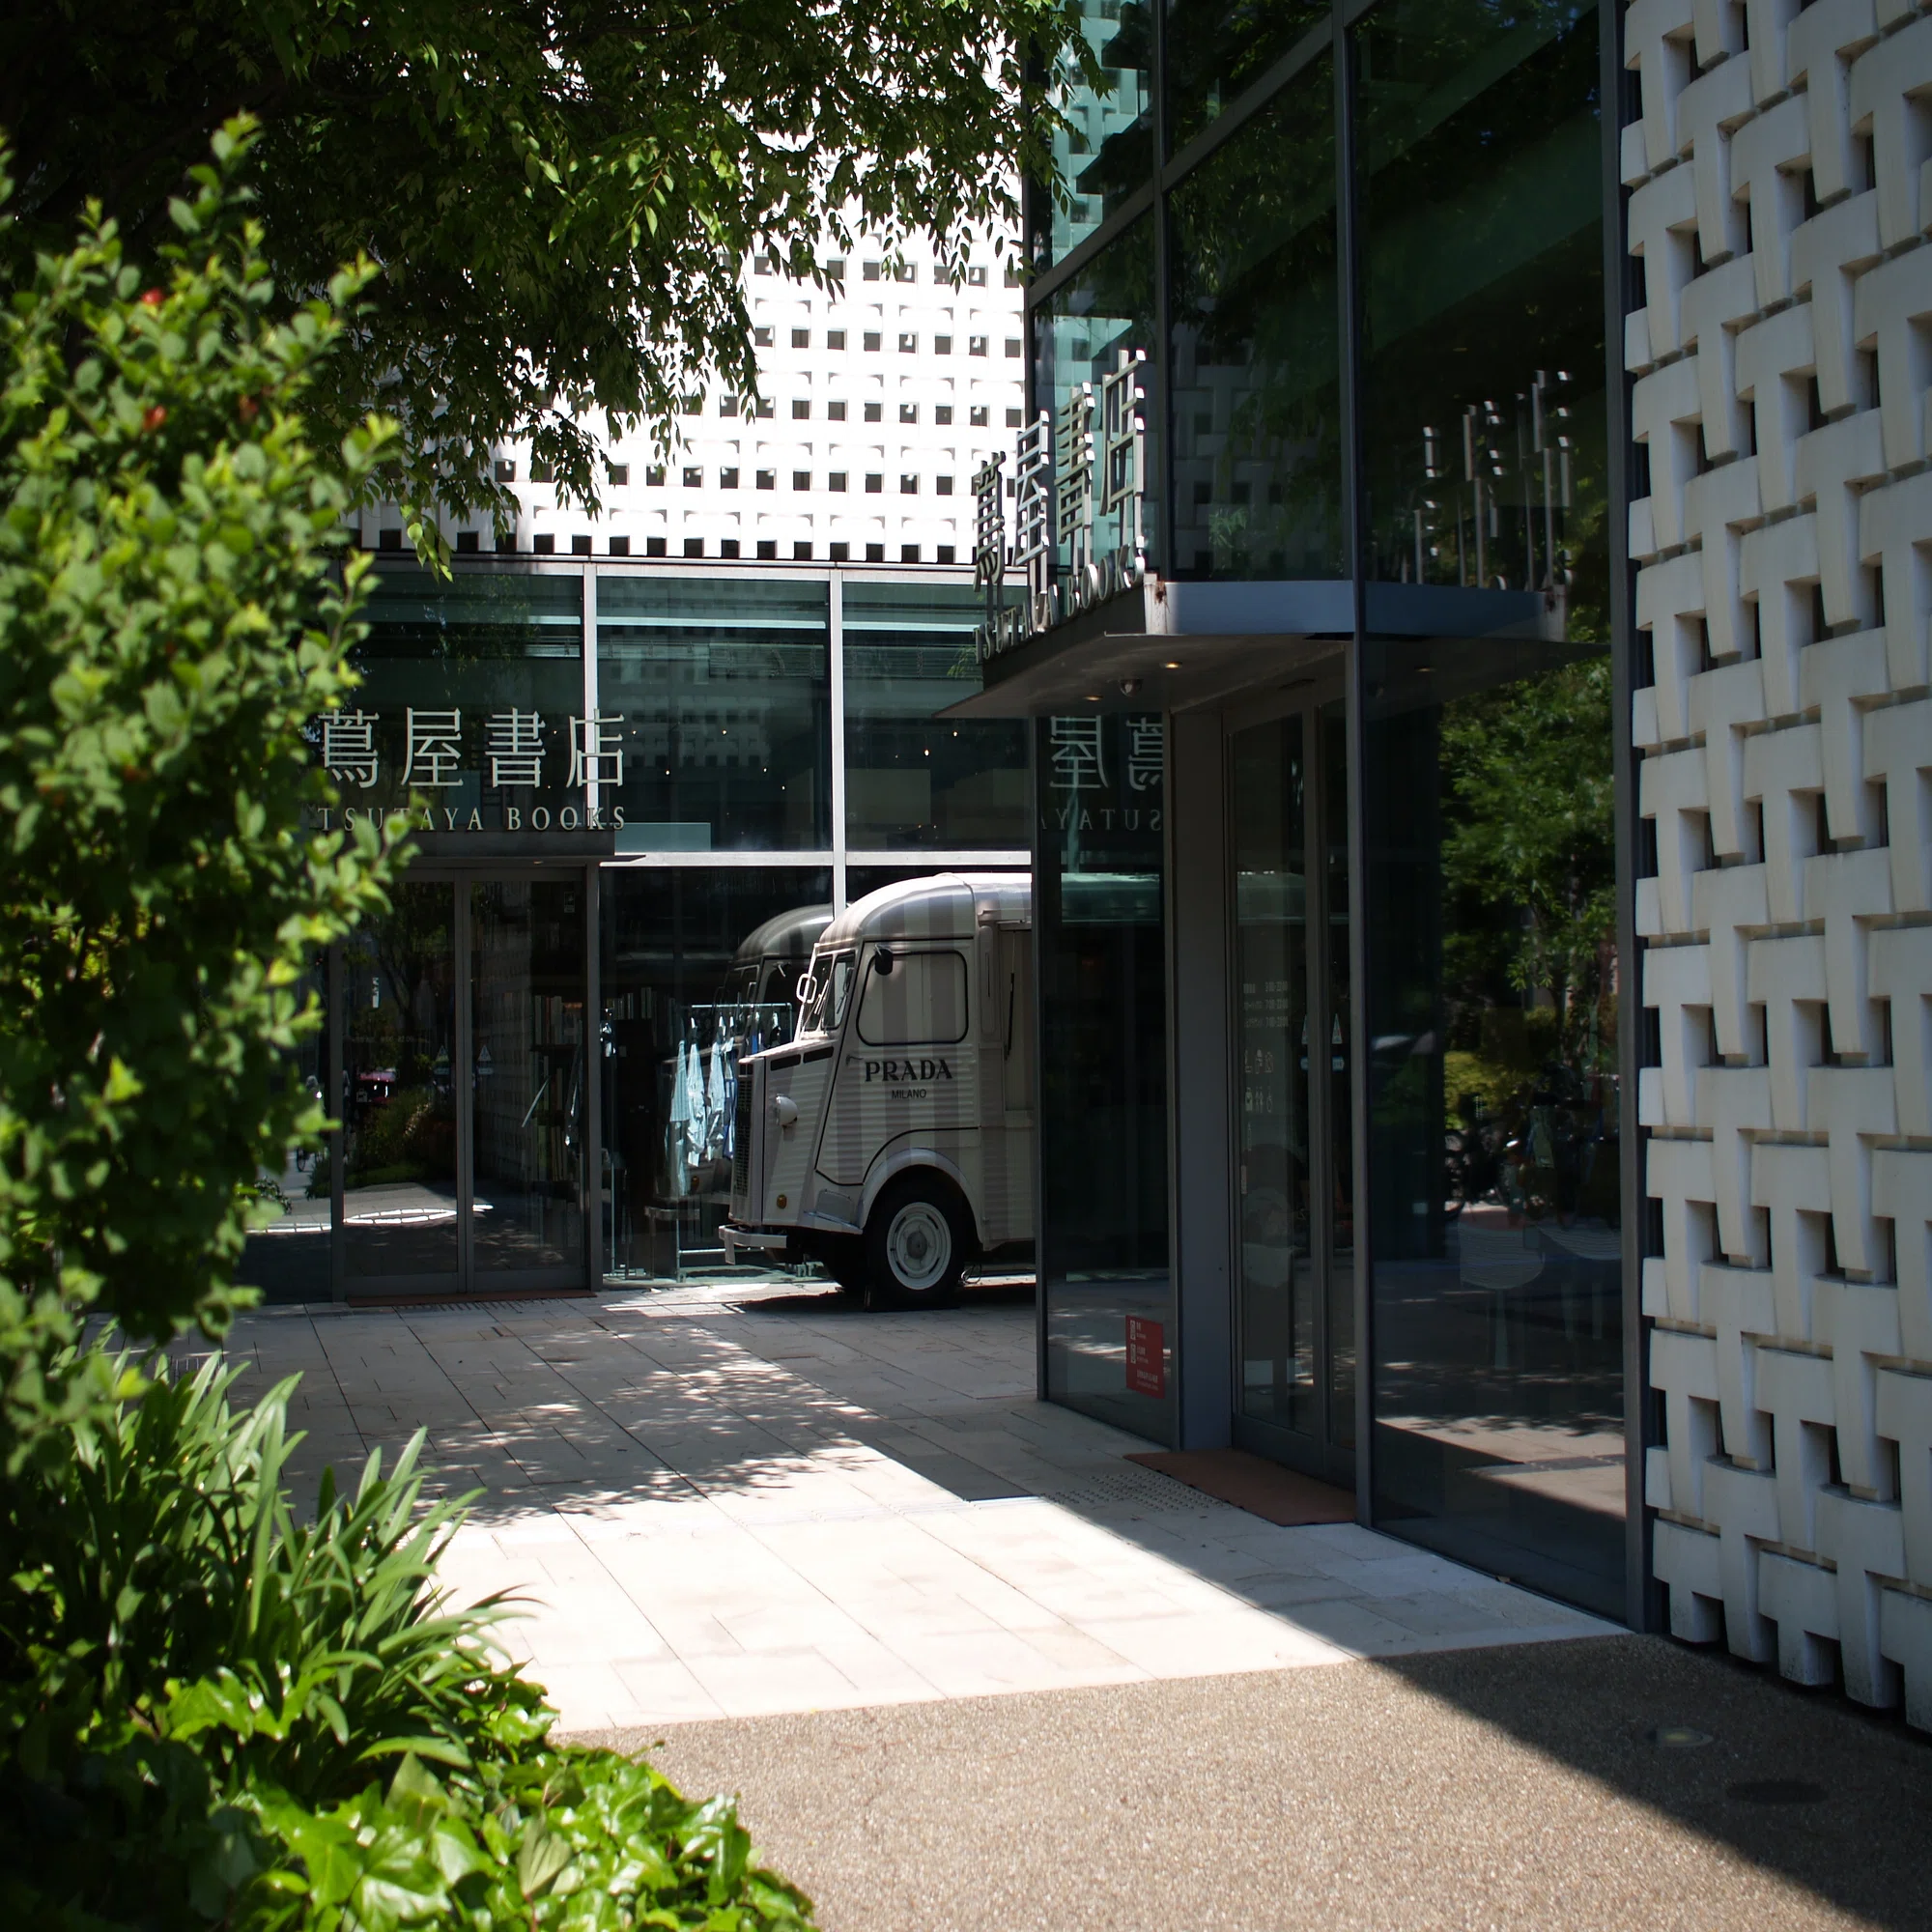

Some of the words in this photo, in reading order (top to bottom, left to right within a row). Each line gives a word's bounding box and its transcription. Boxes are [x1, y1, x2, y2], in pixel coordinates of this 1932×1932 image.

[973, 349, 1147, 592] 蔦屋書店
[974, 583, 1061, 665] TSUTAYA
[1067, 536, 1147, 618] BOOKS
[318, 706, 626, 789] 蔦屋書店
[506, 806, 627, 832] BOOKS
[865, 1059, 952, 1082] PRADA
[891, 1089, 927, 1099] MILANO
